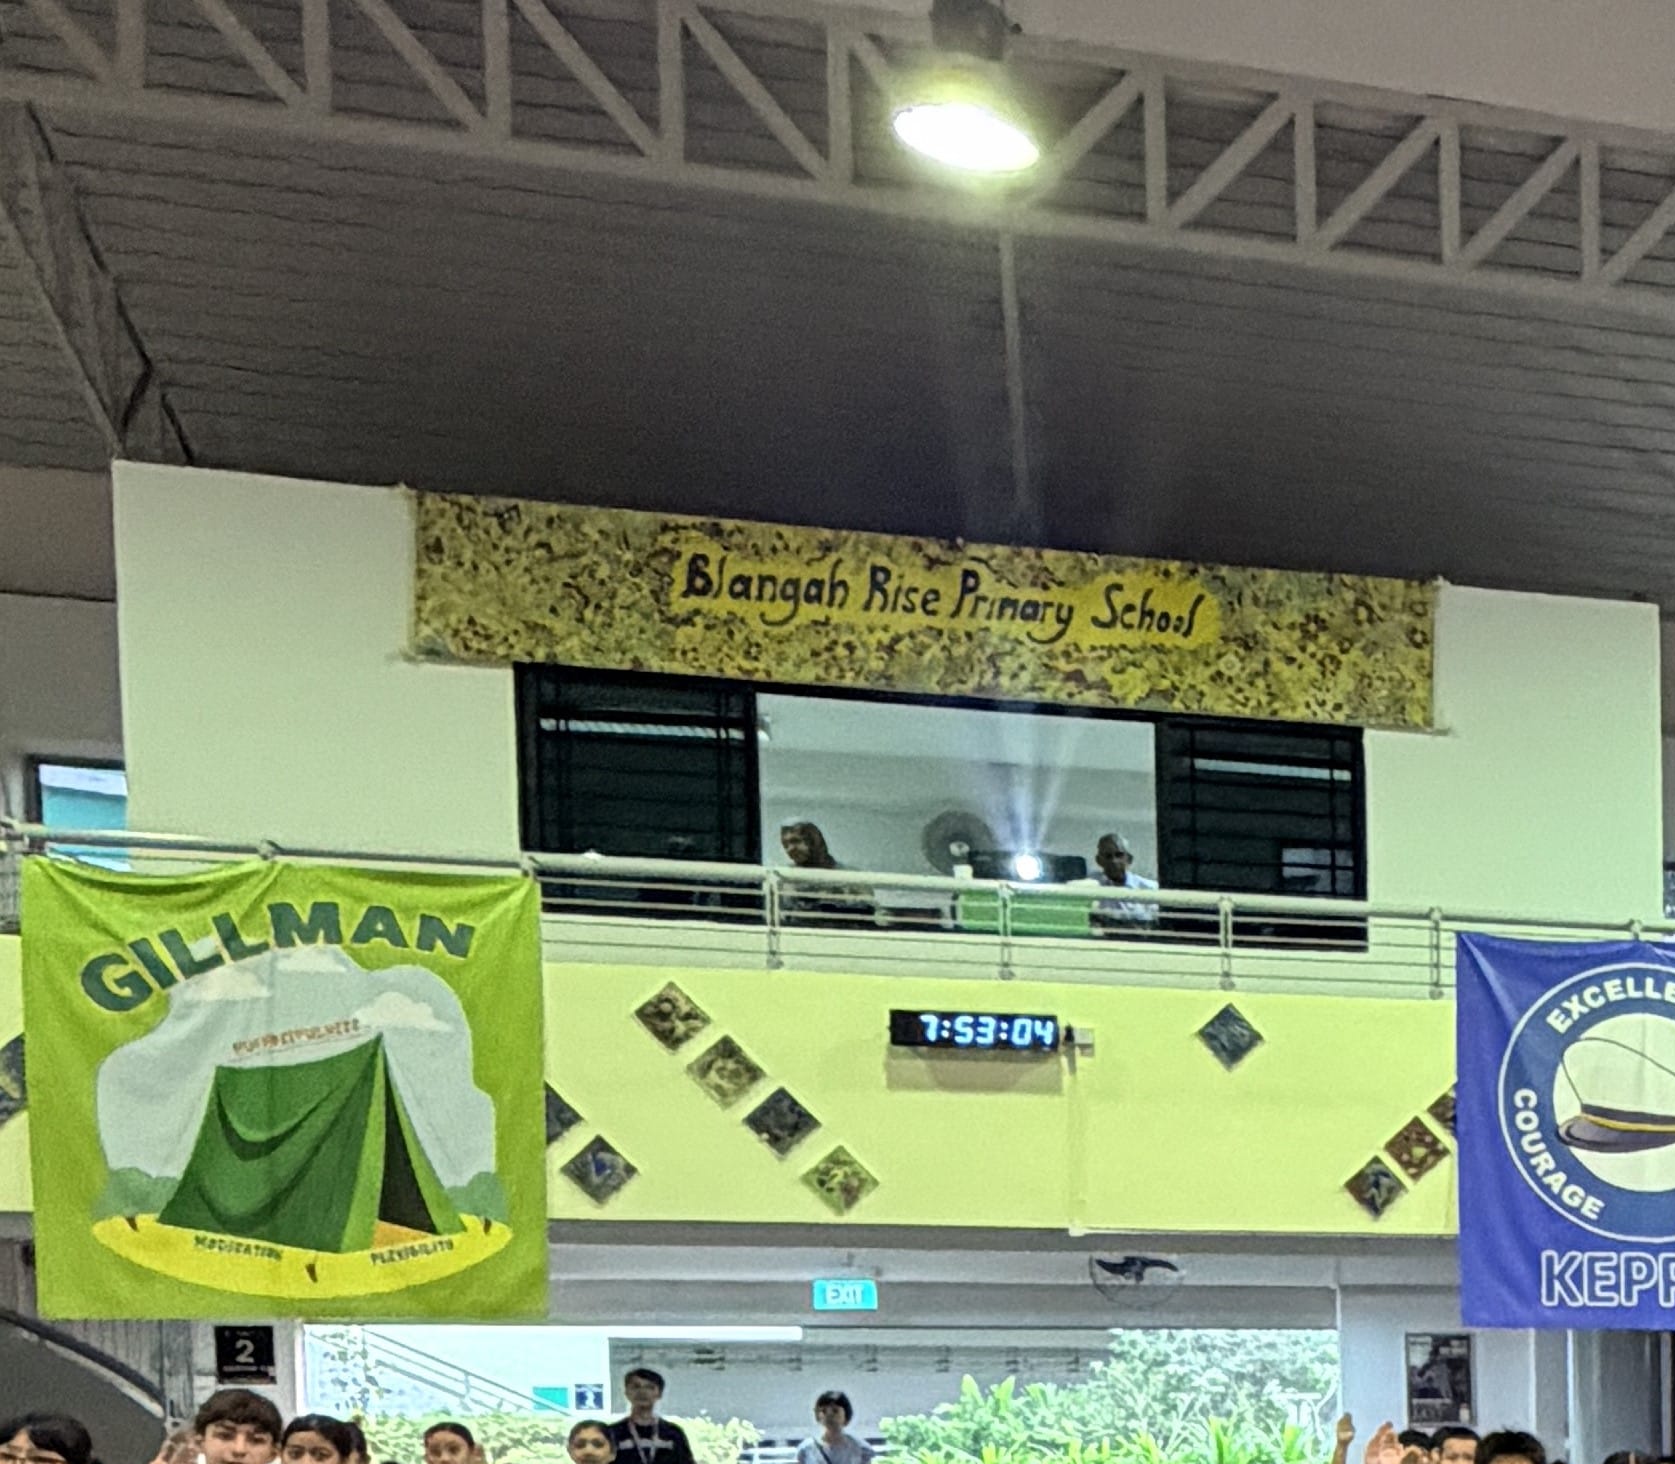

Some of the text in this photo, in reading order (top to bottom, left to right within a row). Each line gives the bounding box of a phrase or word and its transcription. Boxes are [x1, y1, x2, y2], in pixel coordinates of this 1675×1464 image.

[681, 552, 1206, 644] Blangah Rise Primary School
[80, 901, 476, 1013] GILLMAN
[919, 1014, 1055, 1046] 7:53:04
[1513, 1087, 1606, 1221] COURAGE
[234, 1338, 256, 1364] 2
